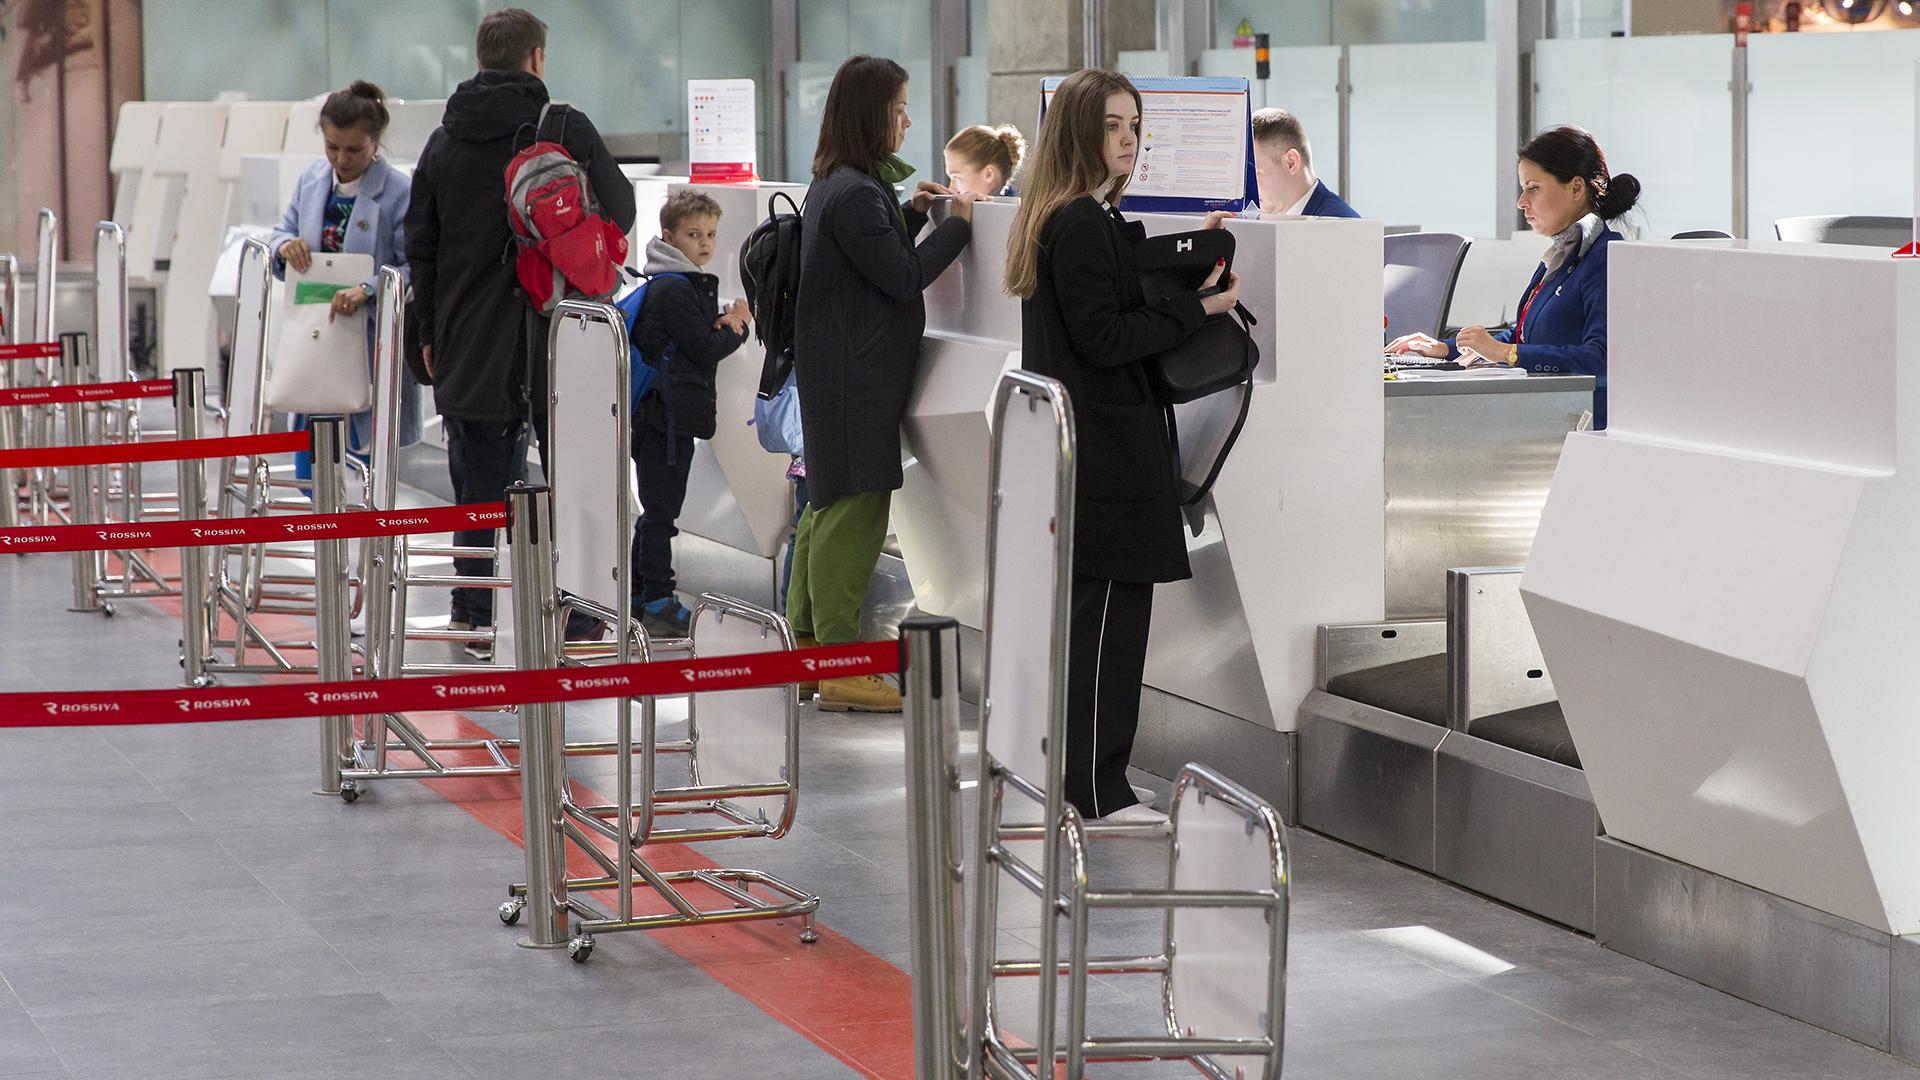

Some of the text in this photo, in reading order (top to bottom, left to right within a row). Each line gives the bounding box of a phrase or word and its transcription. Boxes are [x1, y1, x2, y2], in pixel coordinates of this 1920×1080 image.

[1176, 239, 1193, 253] H
[20, 392, 50, 400] ROSSIYA
[84, 388, 114, 396] ROSSIYA
[13, 535, 57, 544] ROSSIYA
[109, 531, 152, 540] ROSSIYA
[204, 528, 246, 537] ROSSIYA
[296, 522, 338, 531] ROSSIYA
[388, 517, 429, 526] ROSSIYA
[61, 655, 872, 713] ROSSIYA ROSSIYA ROSSIYA ROSSIYA ROSSIYA ROSSIYA ROSSIYA
